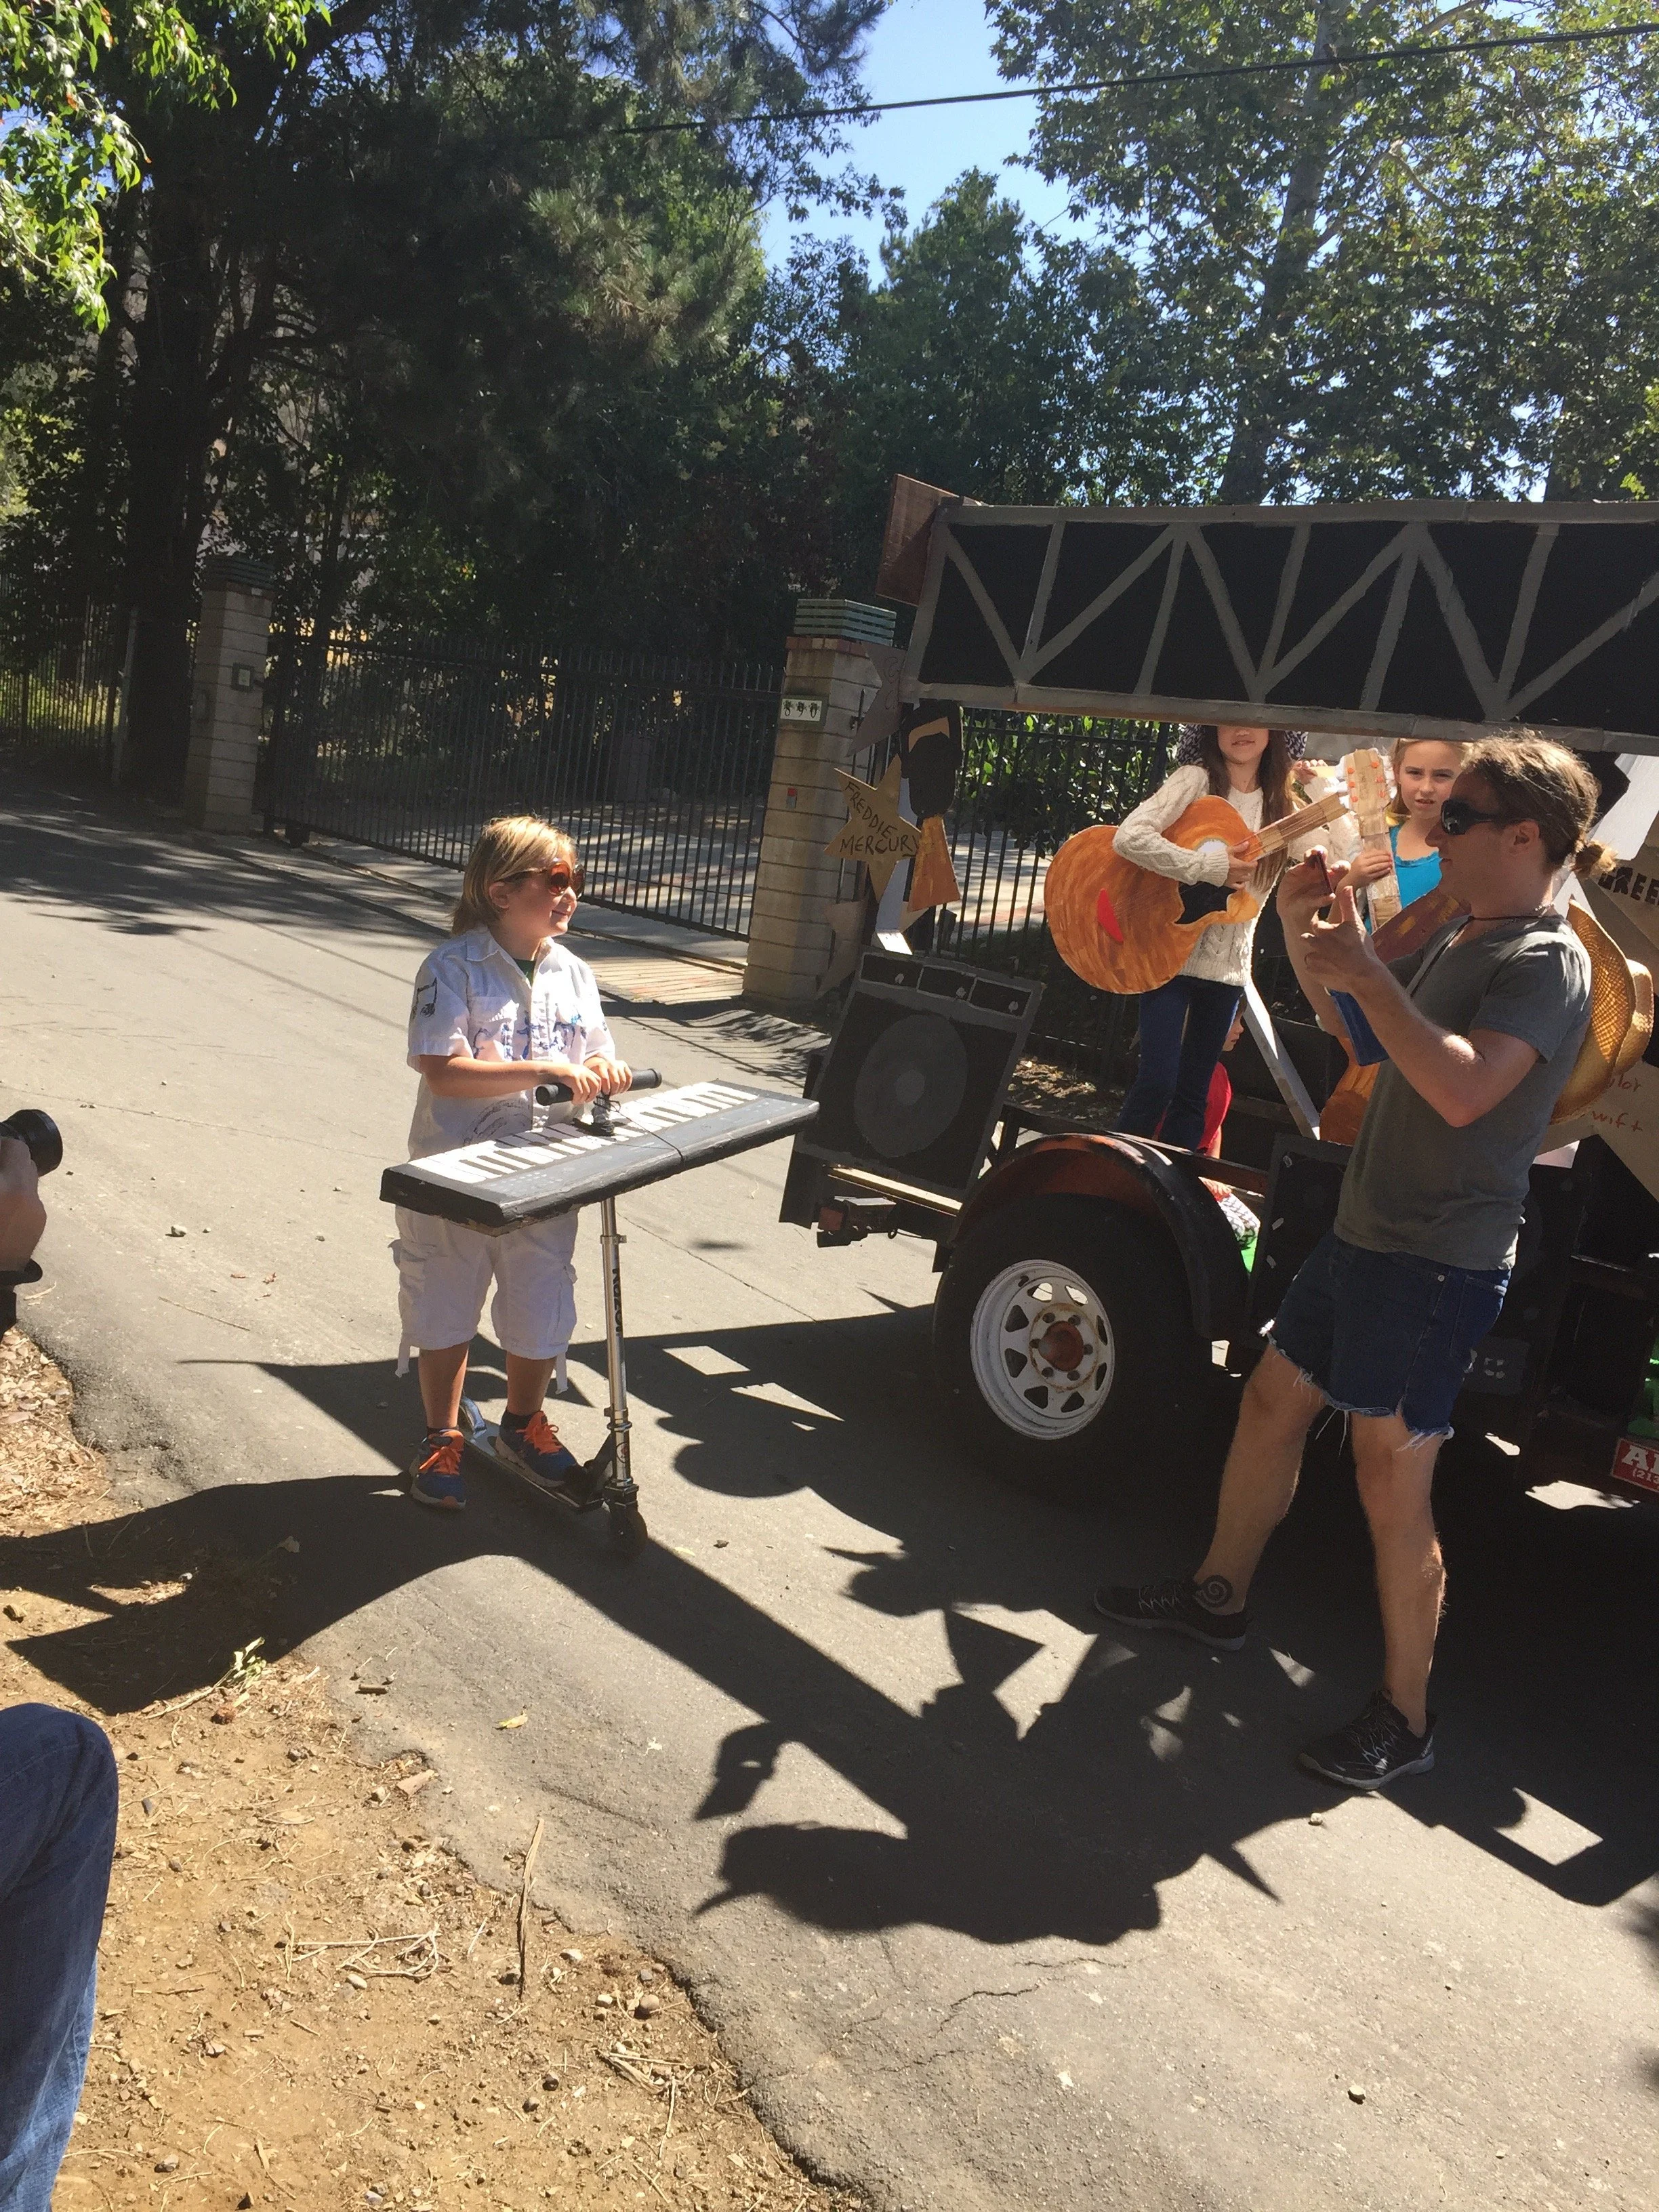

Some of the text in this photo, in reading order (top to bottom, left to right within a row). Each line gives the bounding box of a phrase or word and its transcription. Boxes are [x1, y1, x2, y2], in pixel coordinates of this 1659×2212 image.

[845, 781, 898, 839] FREDDIE
[1598, 867, 1659, 905] GREE
[1580, 1111, 1643, 1132] wift
